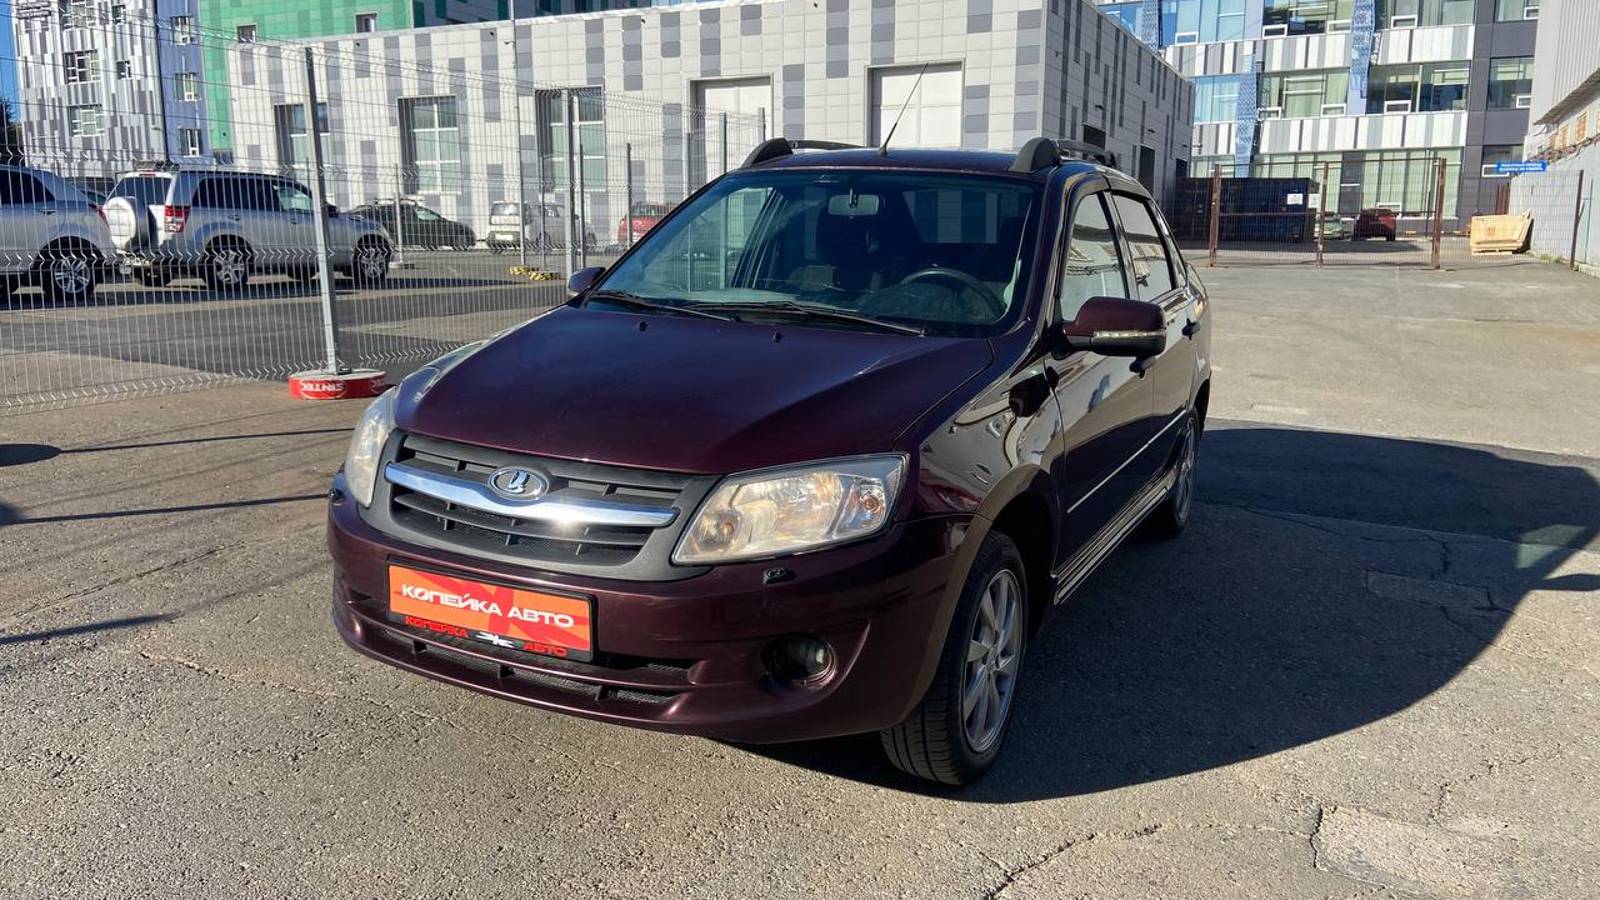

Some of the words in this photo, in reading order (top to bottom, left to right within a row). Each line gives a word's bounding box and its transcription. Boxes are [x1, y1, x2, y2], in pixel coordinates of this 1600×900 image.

[402, 584, 503, 616] КОПЕЙКА
[508, 606, 574, 628] АВТО
[523, 643, 568, 657] АВТО
